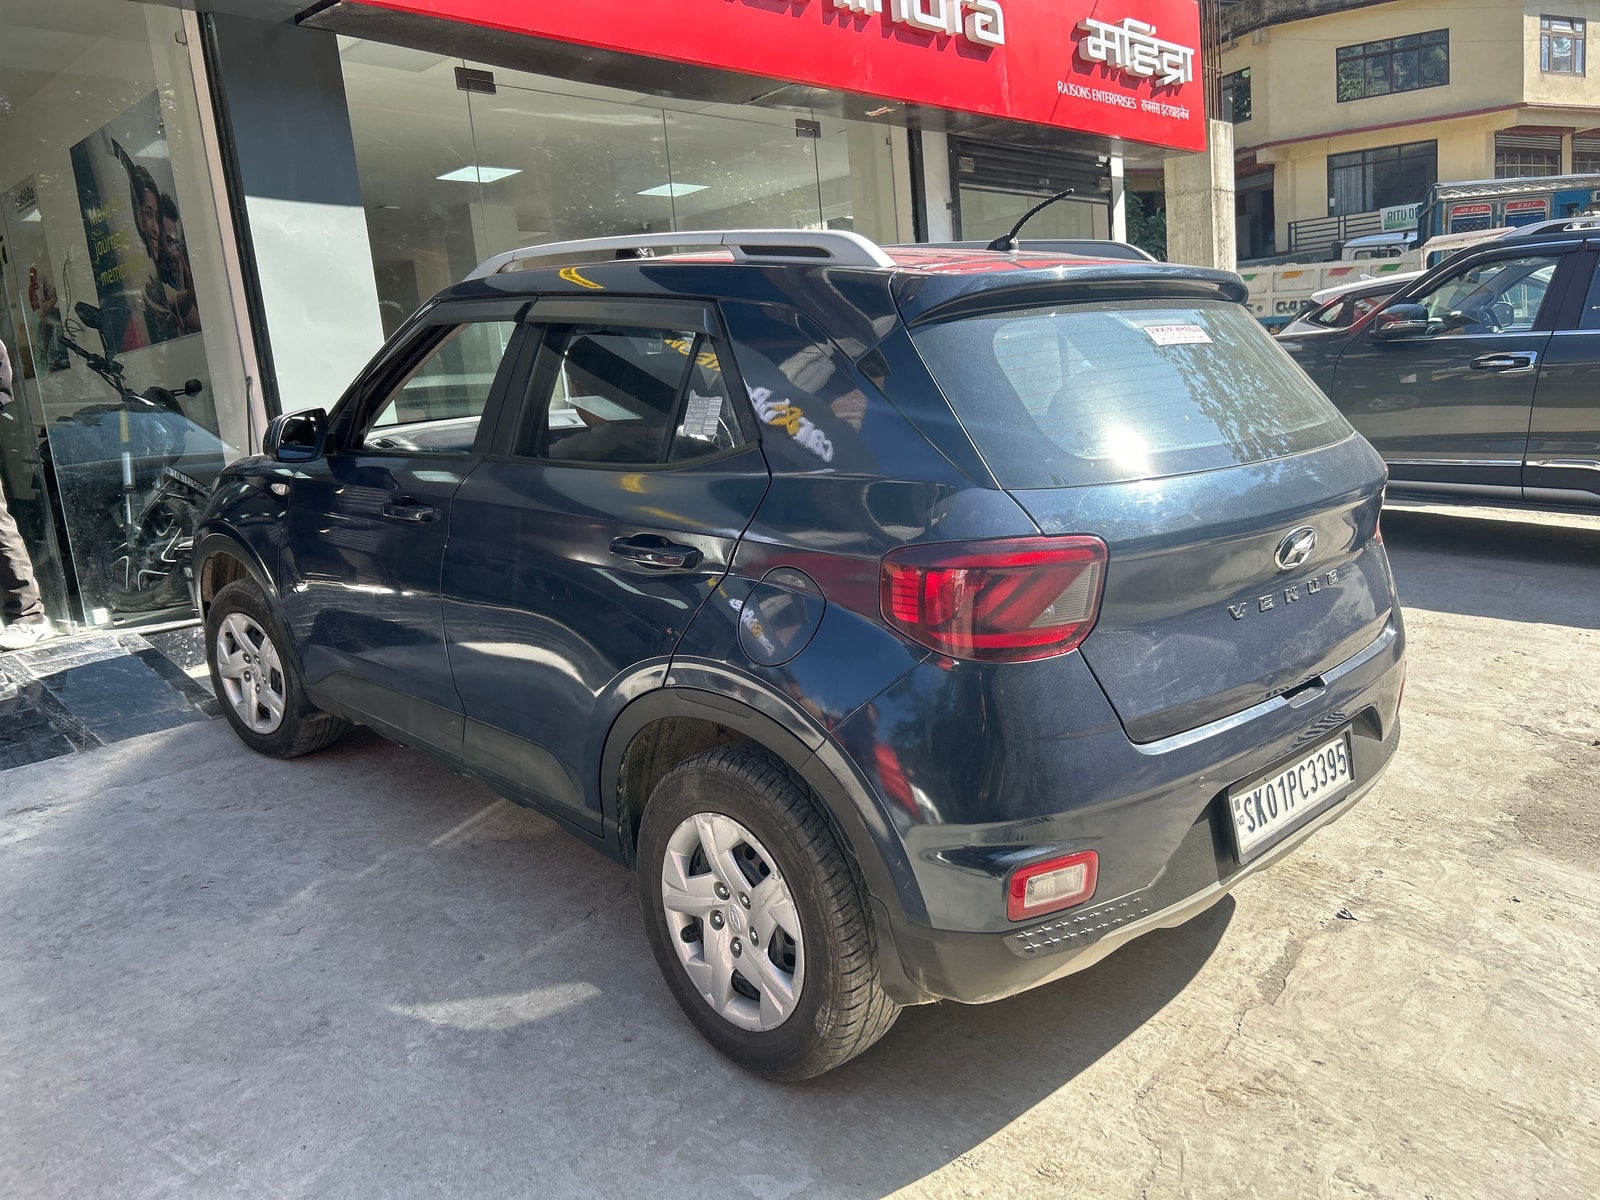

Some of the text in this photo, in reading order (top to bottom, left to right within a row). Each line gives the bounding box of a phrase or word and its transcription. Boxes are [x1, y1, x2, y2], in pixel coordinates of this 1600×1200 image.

[1079, 17, 1195, 86] महिंद्रा
[1057, 80, 1137, 110] RAJSONS ENTERPRISES
[1387, 209, 1407, 223] RITU
[1227, 569, 1338, 621] VENUE
[1244, 742, 1347, 833] SK01PC3395
